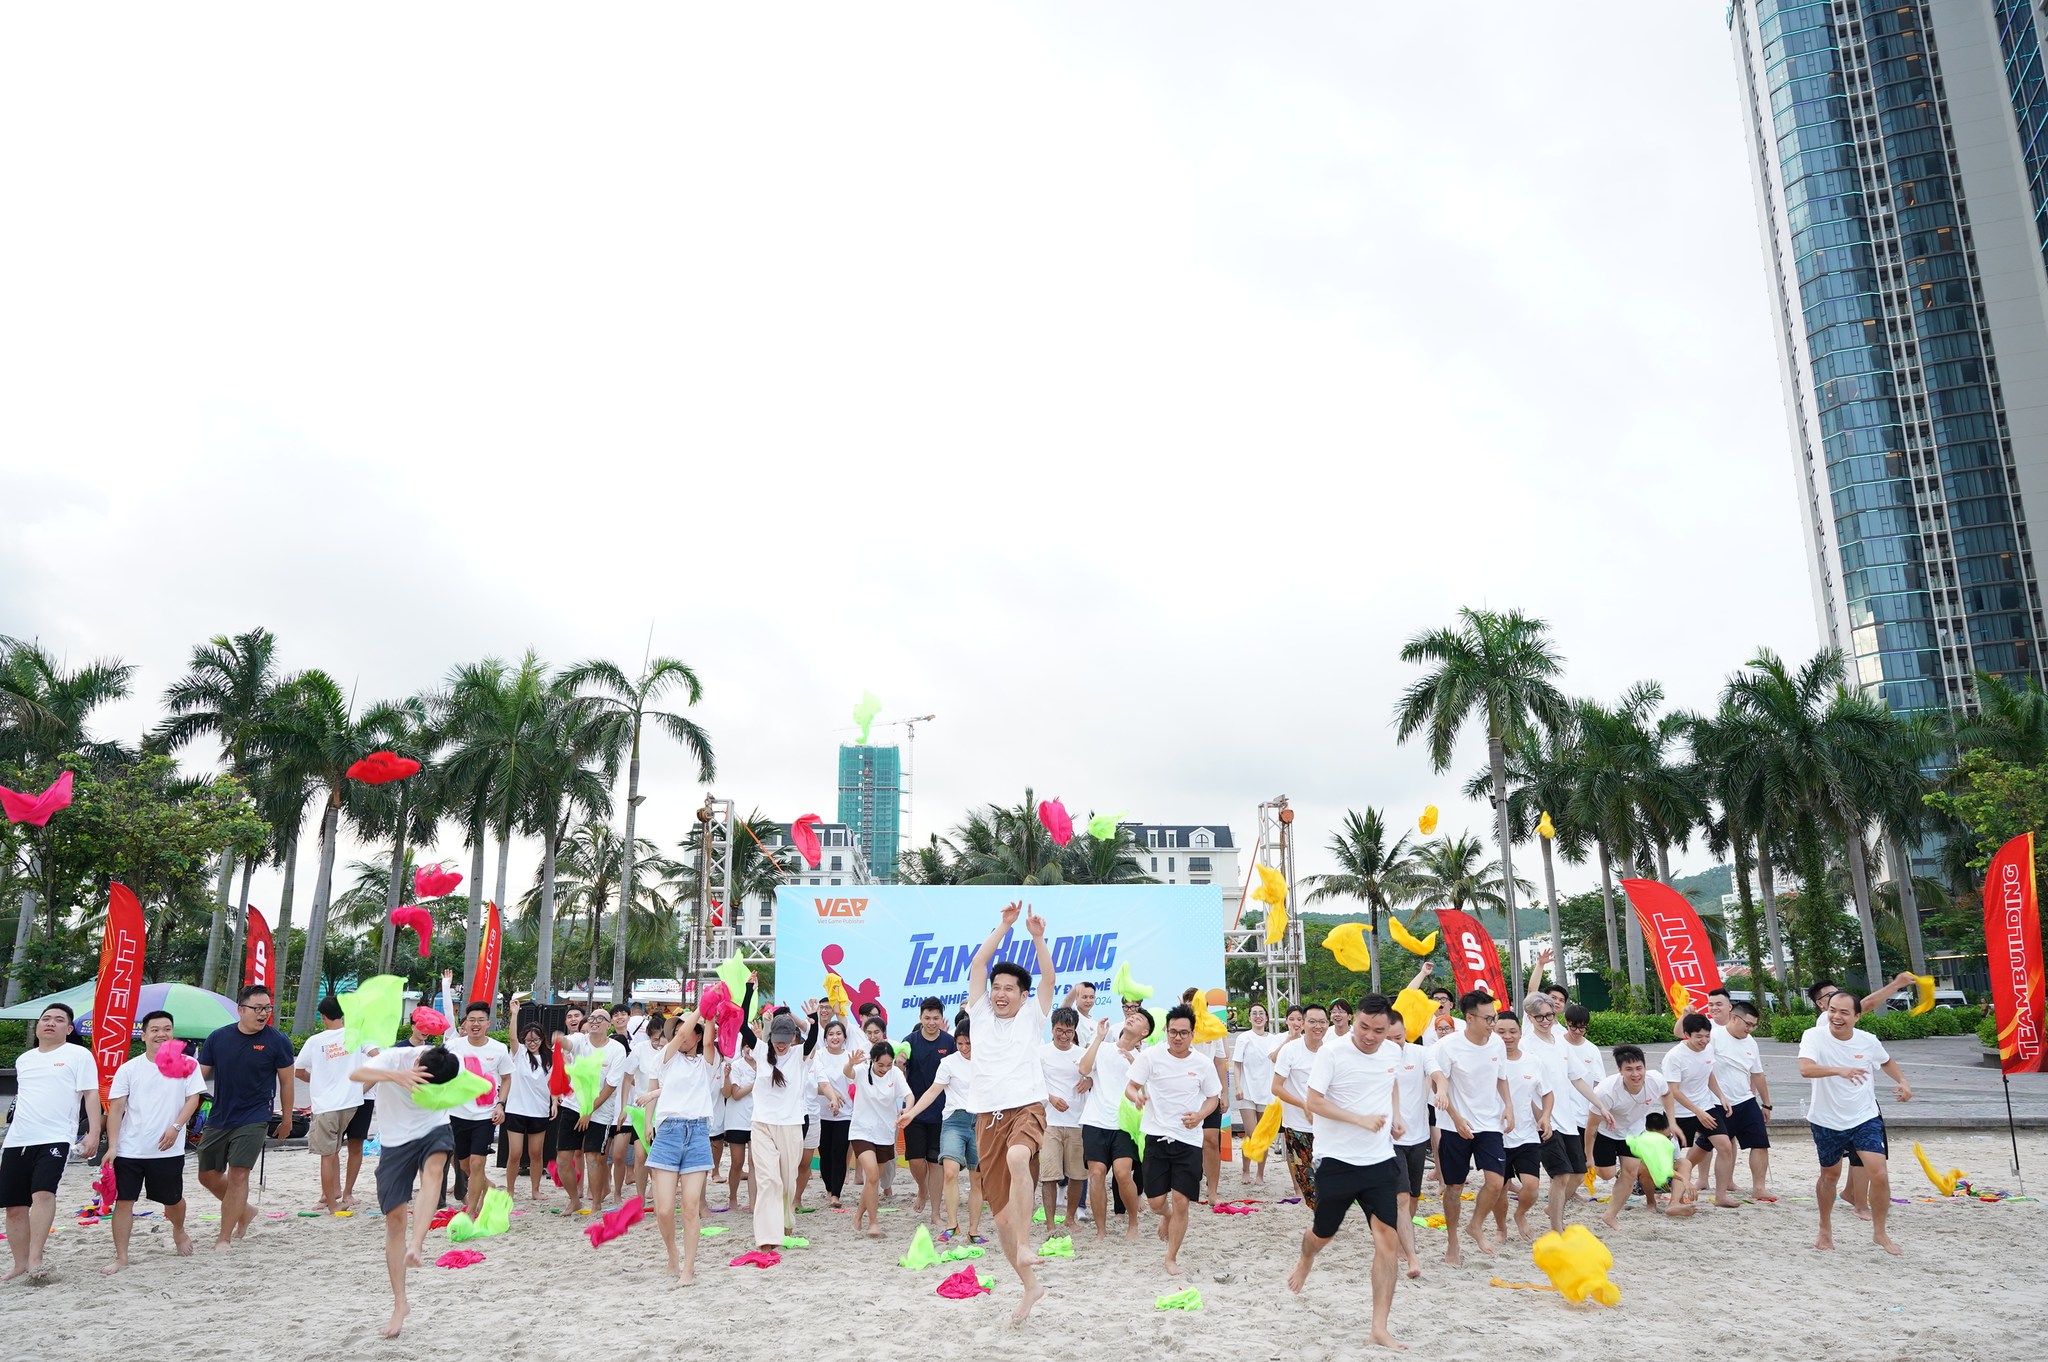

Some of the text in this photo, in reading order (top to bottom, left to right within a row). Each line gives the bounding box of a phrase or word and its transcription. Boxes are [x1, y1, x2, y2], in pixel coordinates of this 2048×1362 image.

[814, 898, 868, 917] VGP
[254, 940, 268, 986] UP
[1461, 931, 1485, 971] UP
[1652, 912, 1713, 1021] VENT
[2003, 864, 2039, 1060] TEAMBUILDING
[1094, 996, 1112, 1006] 024
